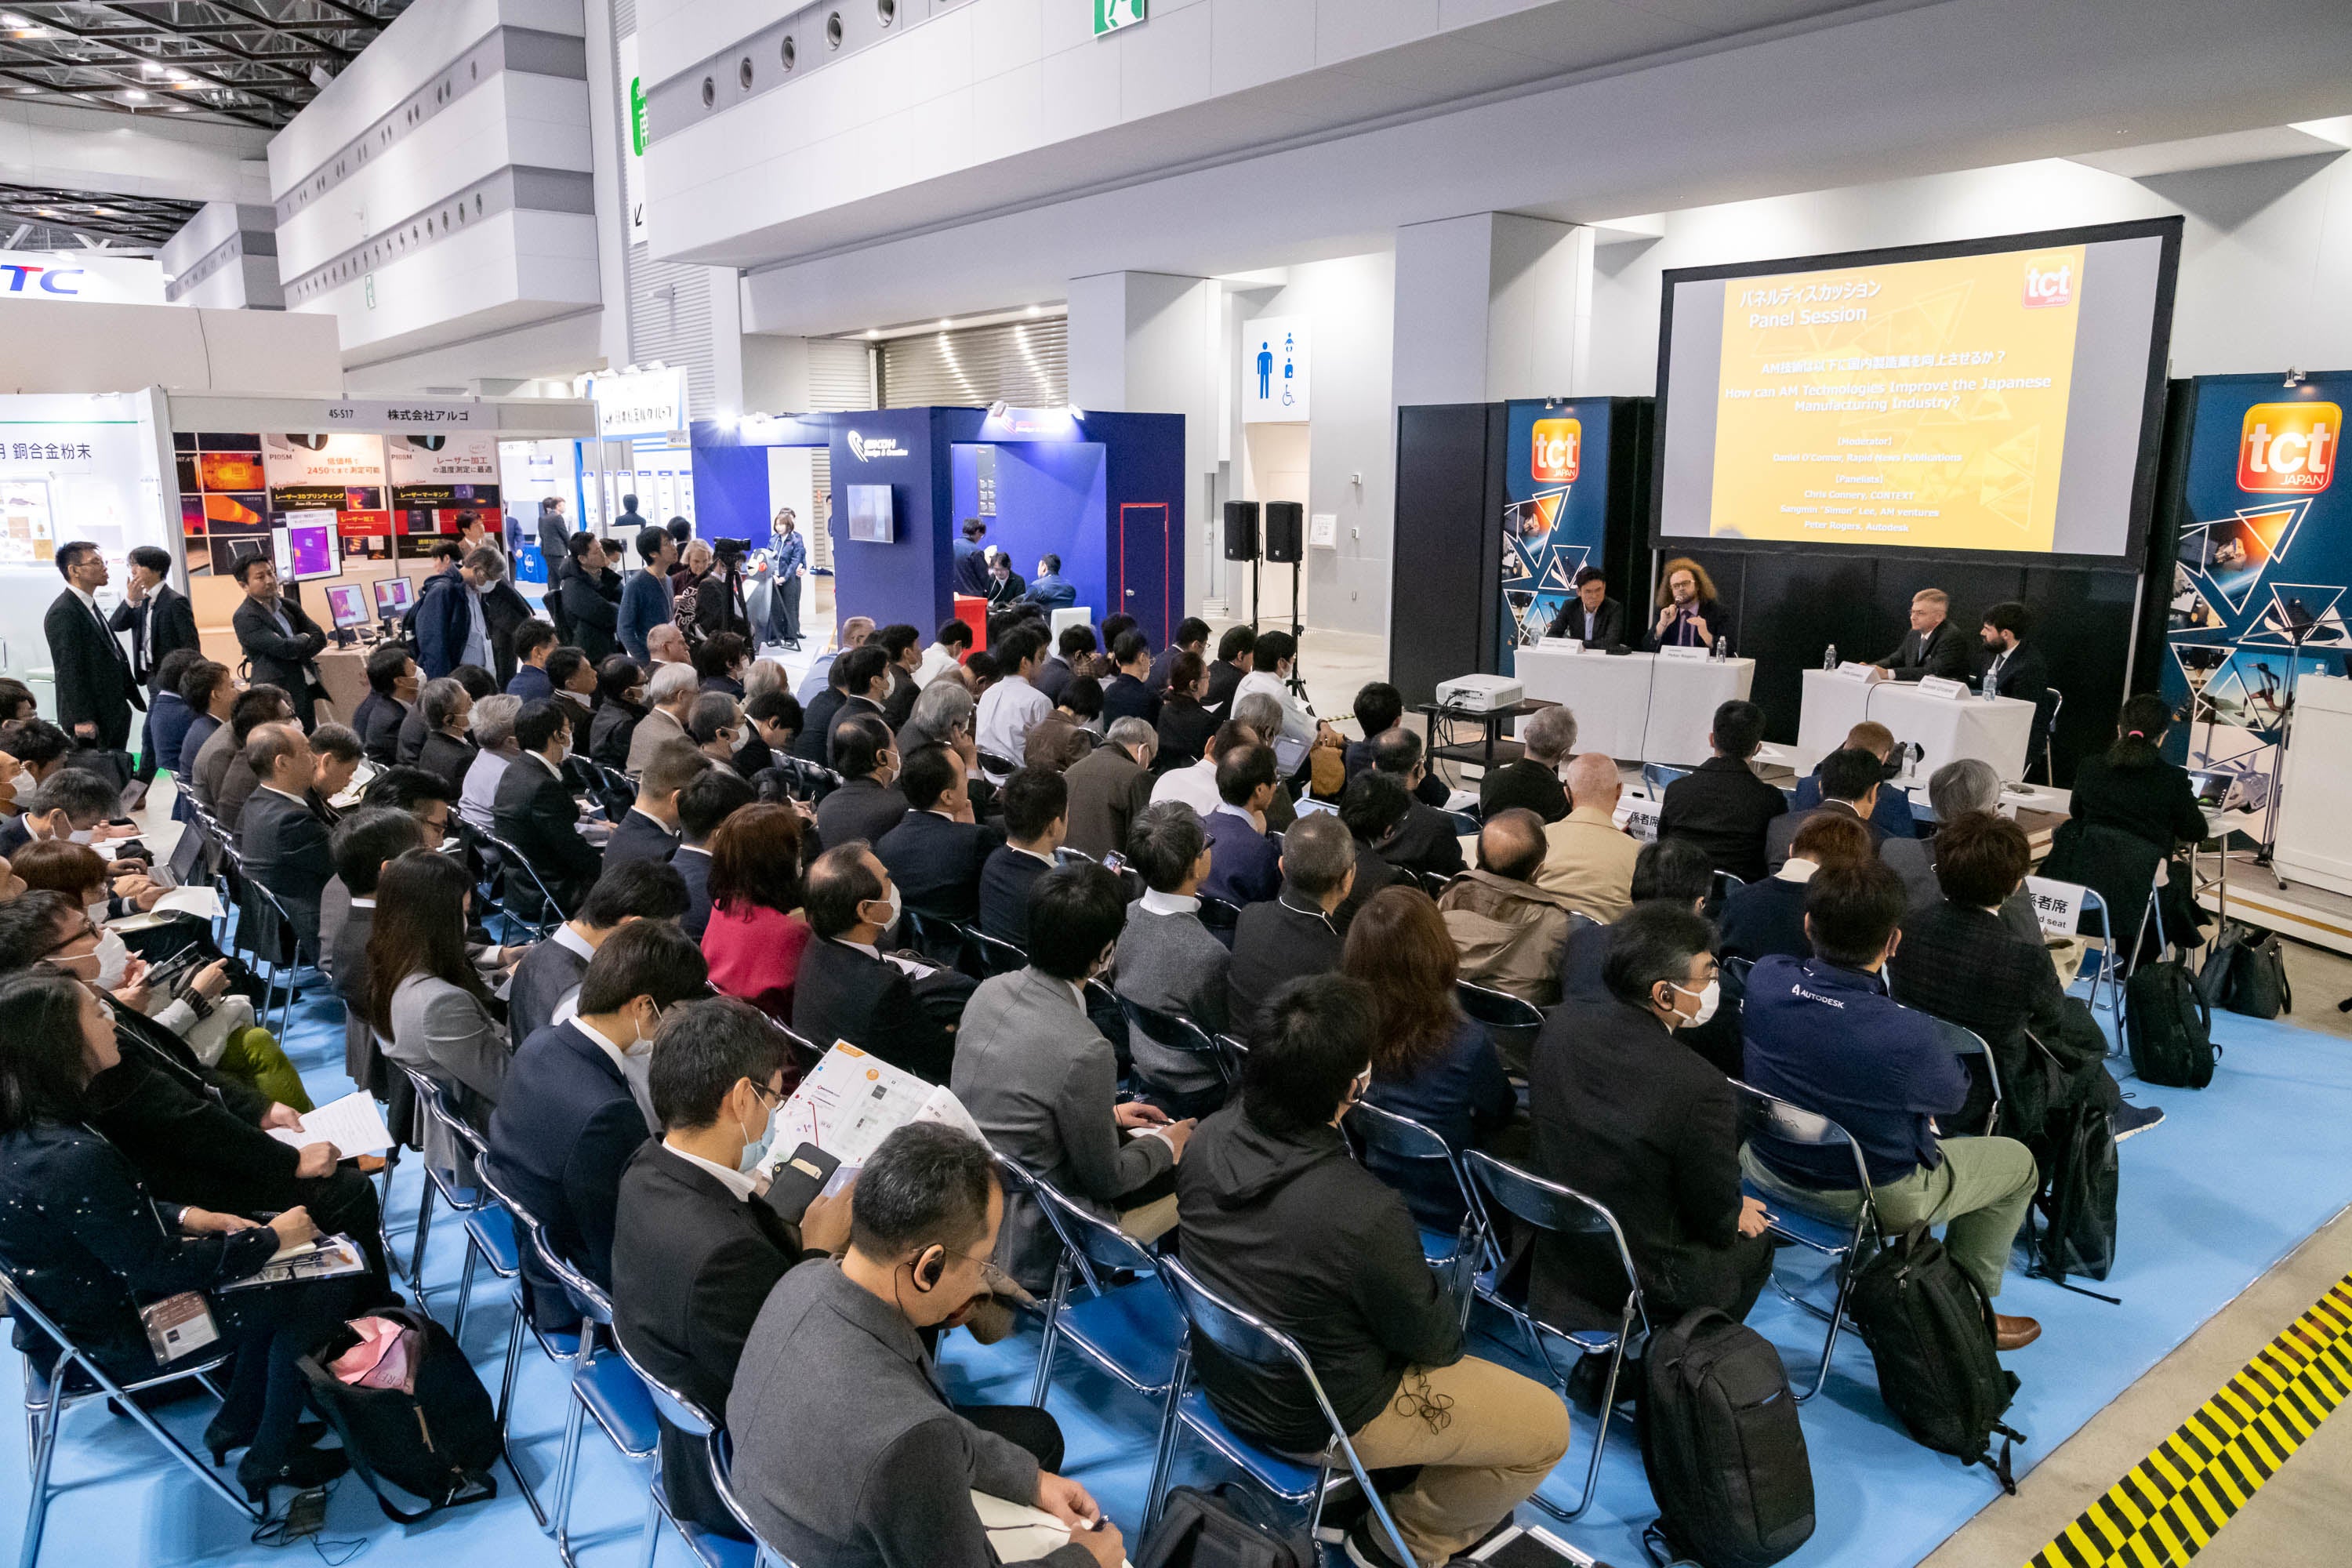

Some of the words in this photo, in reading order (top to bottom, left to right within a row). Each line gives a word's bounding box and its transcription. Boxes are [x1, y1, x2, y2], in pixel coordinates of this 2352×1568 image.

[2027, 265, 2071, 297] tct
[1740, 281, 1882, 307] パネルディスカッション
[1749, 310, 1795, 328] Panel
[1799, 306, 1867, 325] Session
[1725, 388, 1750, 399] How
[1755, 387, 1776, 397] can
[1779, 385, 1798, 396] AM
[1802, 383, 1885, 397] Technologies
[1889, 380, 1949, 394] Improve
[1951, 378, 1976, 390] the
[1981, 376, 2052, 391] Japanese
[1795, 398, 1887, 412] Manufacturing
[1891, 394, 1960, 410] Industry?
[328, 409, 354, 419] 4S-S17
[387, 409, 470, 422] 株式会社アルゴ
[13, 442, 92, 460] 銅合金粉末
[1535, 433, 1577, 469] tct
[2249, 424, 2331, 474] tct
[437, 456, 488, 465] レーザー加工
[1773, 453, 1800, 462] Daniel
[1846, 453, 1873, 463] Rapid
[1903, 453, 1962, 462] Publications
[1553, 469, 1576, 477] JAPAN
[2281, 474, 2325, 486] JAPAN
[1804, 490, 1827, 499] Chris
[1871, 491, 1915, 500] CONTEXT
[1880, 507, 1895, 516] AM
[1897, 508, 1940, 517] ventures
[1804, 520, 1827, 529] Peter
[1865, 523, 1909, 532] Autodesk
[2047, 918, 2067, 929] seat
[1800, 989, 1845, 1009] AUTODESK
